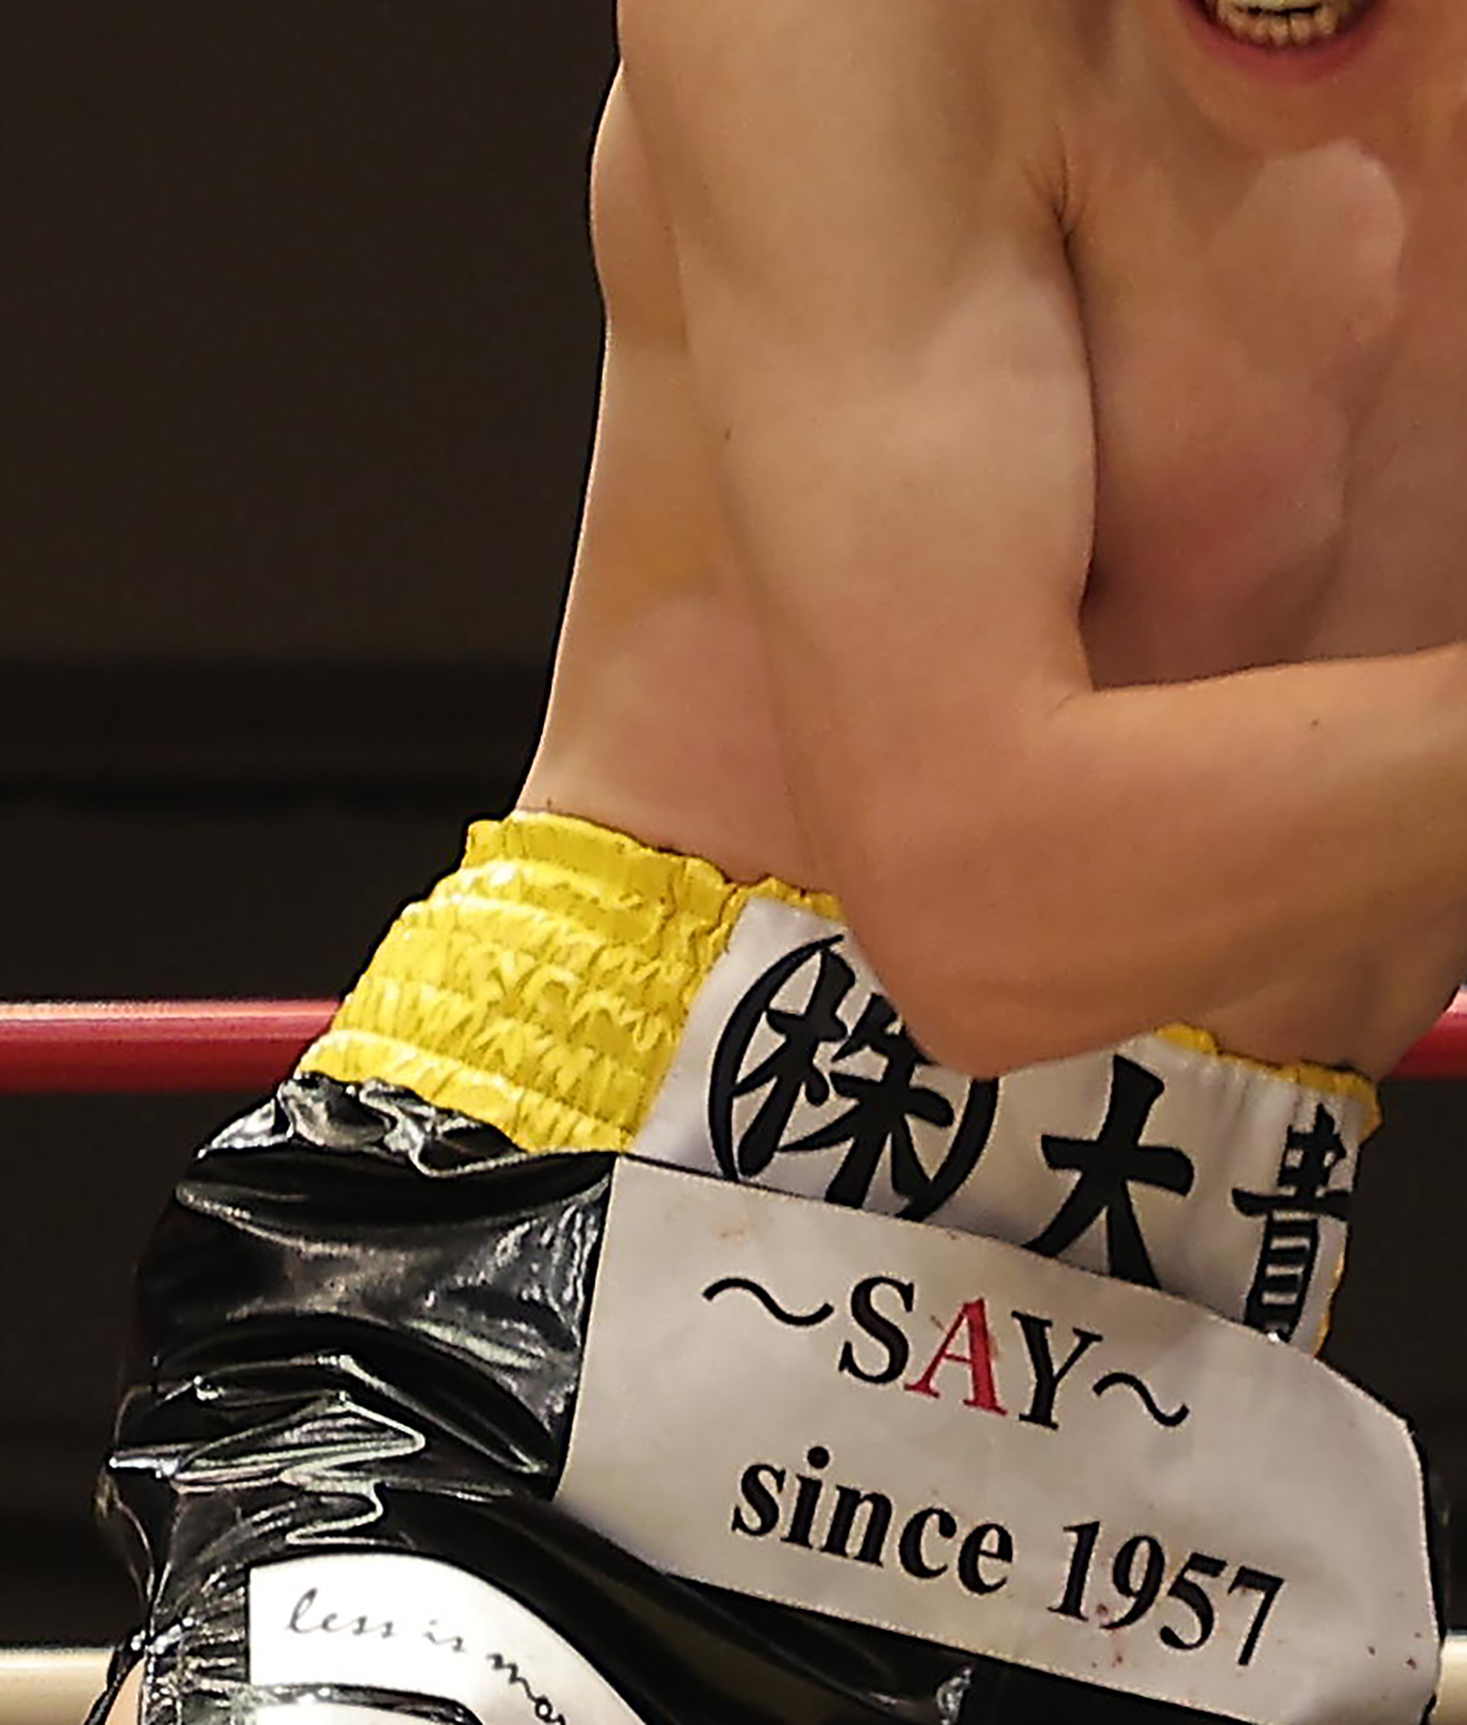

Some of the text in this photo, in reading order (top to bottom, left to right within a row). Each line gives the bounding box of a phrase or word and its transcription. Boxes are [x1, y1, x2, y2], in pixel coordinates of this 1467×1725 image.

[286, 1587, 398, 1640] less
[421, 1619, 467, 1653] is
[732, 1445, 1286, 1668] since 1957
